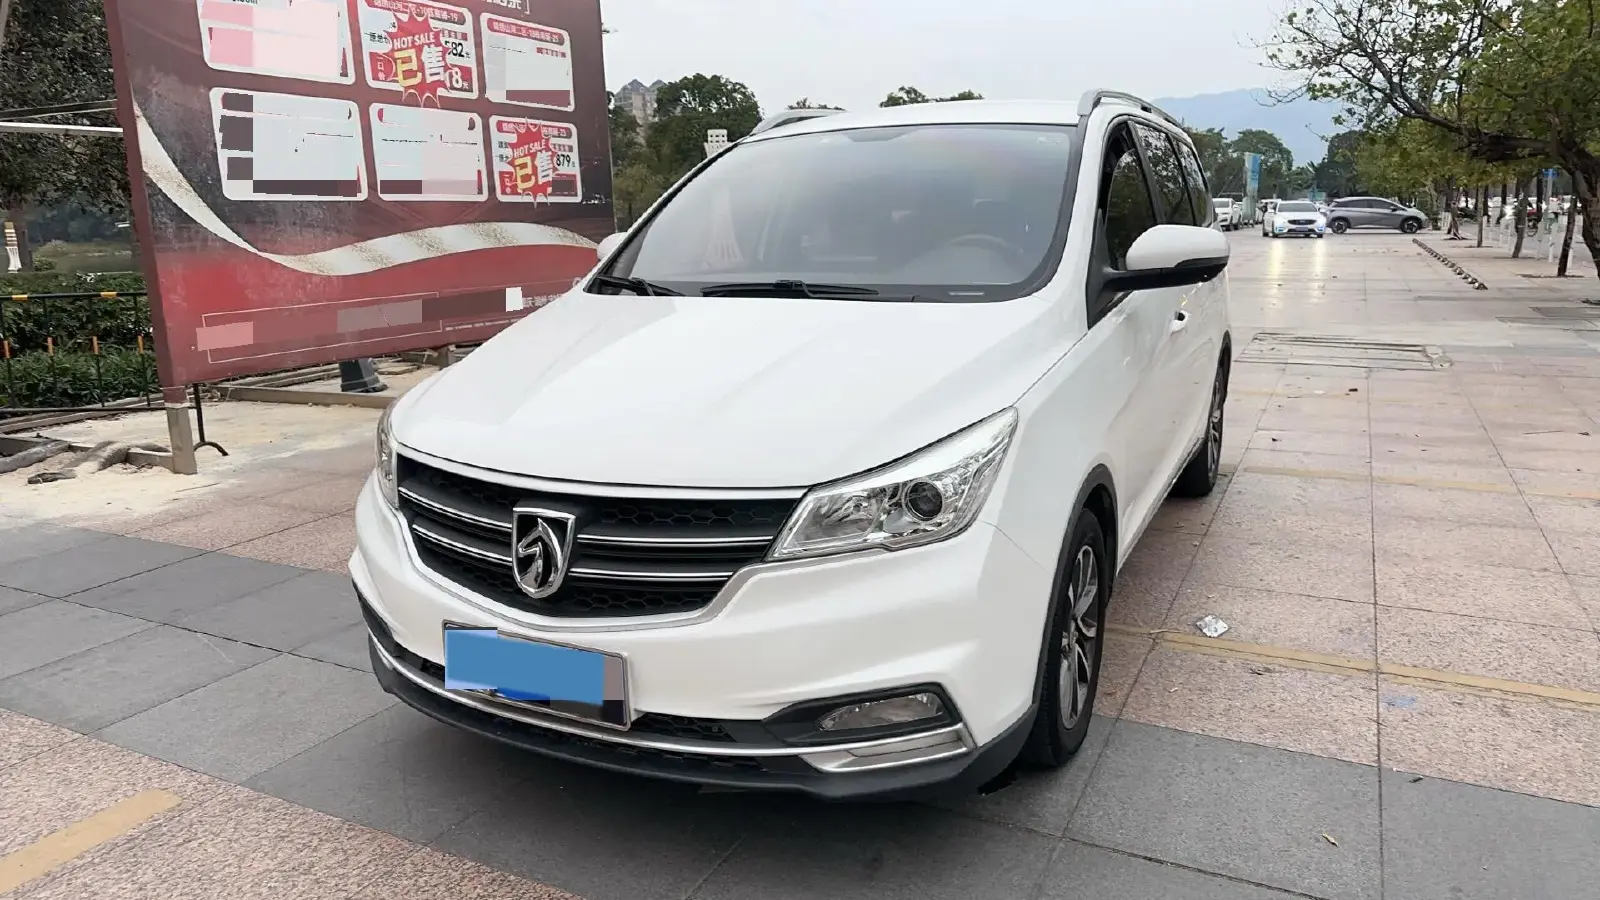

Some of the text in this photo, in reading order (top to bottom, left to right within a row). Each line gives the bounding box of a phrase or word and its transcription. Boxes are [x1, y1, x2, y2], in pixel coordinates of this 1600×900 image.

[393, 36, 412, 50] HOT
[413, 31, 435, 45] SALE
[394, 44, 445, 88] 已售
[513, 146, 529, 158] HOT
[529, 139, 546, 153] SALE
[515, 150, 553, 190] 已售
